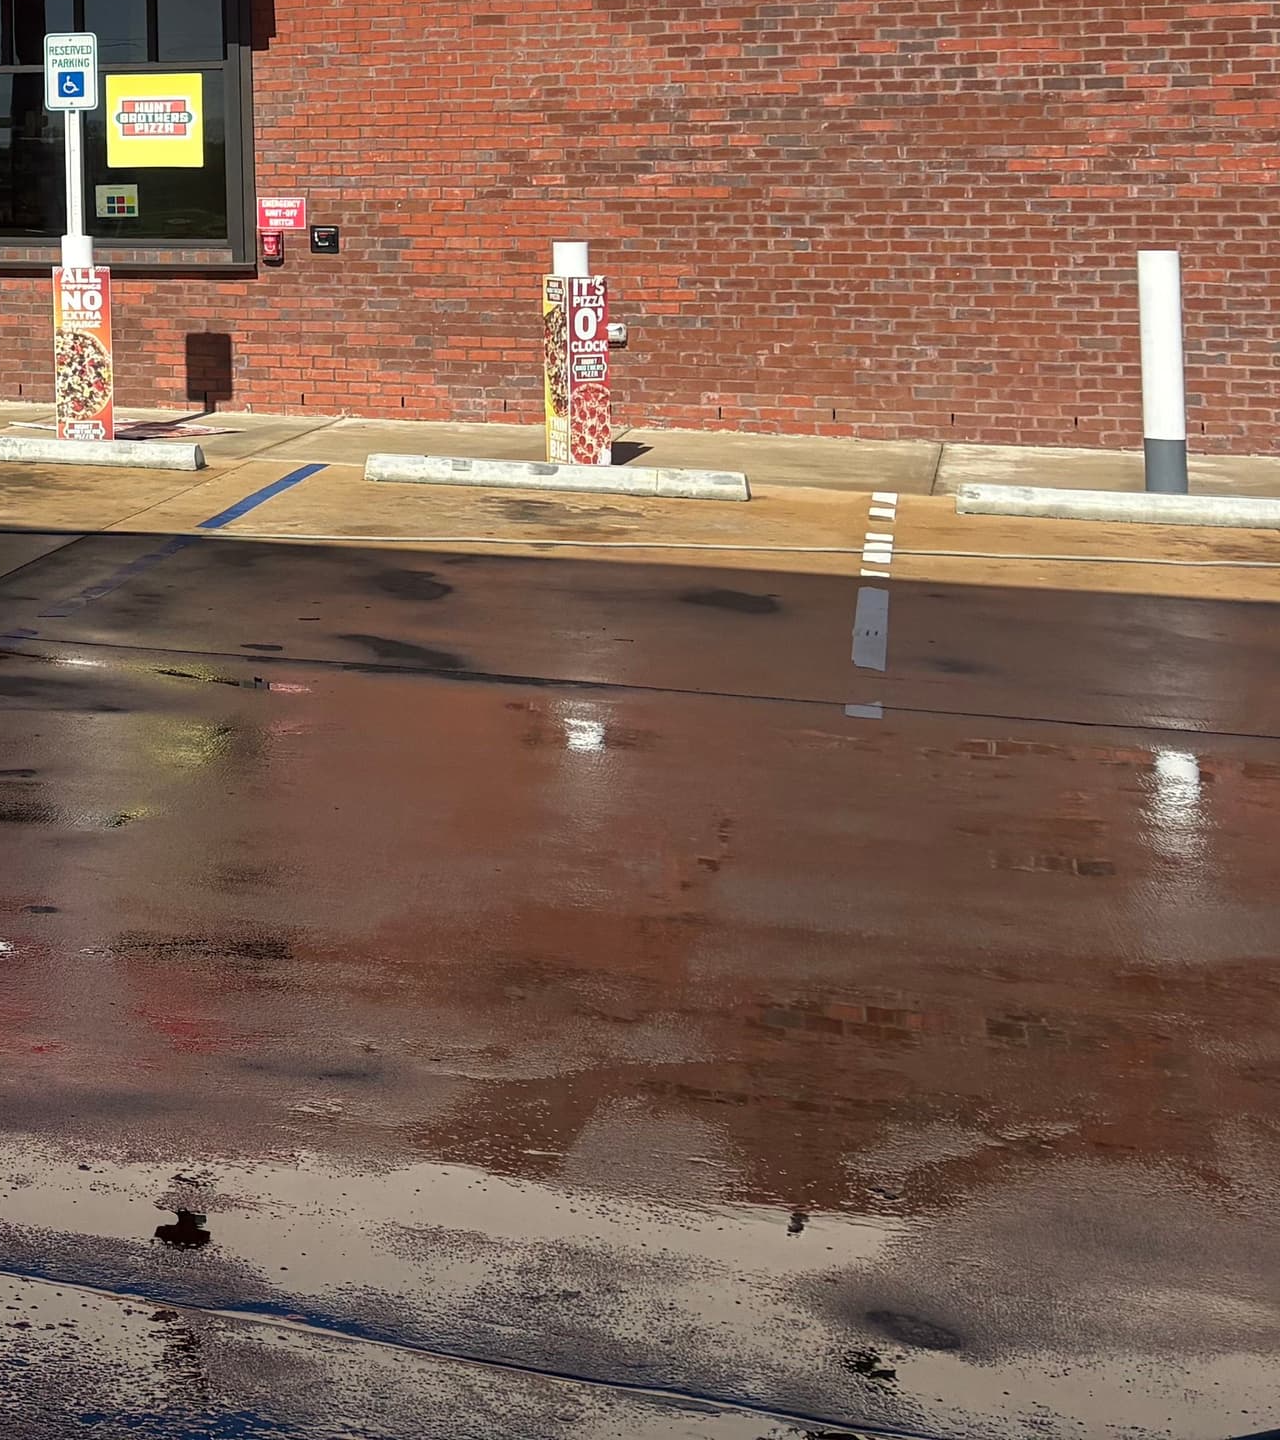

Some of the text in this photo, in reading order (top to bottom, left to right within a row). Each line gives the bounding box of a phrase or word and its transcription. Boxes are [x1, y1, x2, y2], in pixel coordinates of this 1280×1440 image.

[49, 45, 92, 56] RESERVED
[52, 58, 90, 68] PARKING
[135, 102, 172, 112] HUNT
[120, 112, 190, 123] BROTHERS
[135, 123, 175, 134] PIZZA
[60, 267, 101, 283] ALL
[572, 275, 605, 296] IT'S
[61, 290, 102, 311] NO
[572, 295, 605, 307] PIZZA
[62, 311, 102, 320] EXTRA
[571, 340, 608, 352] CLOCK
[550, 440, 568, 459] BIG
